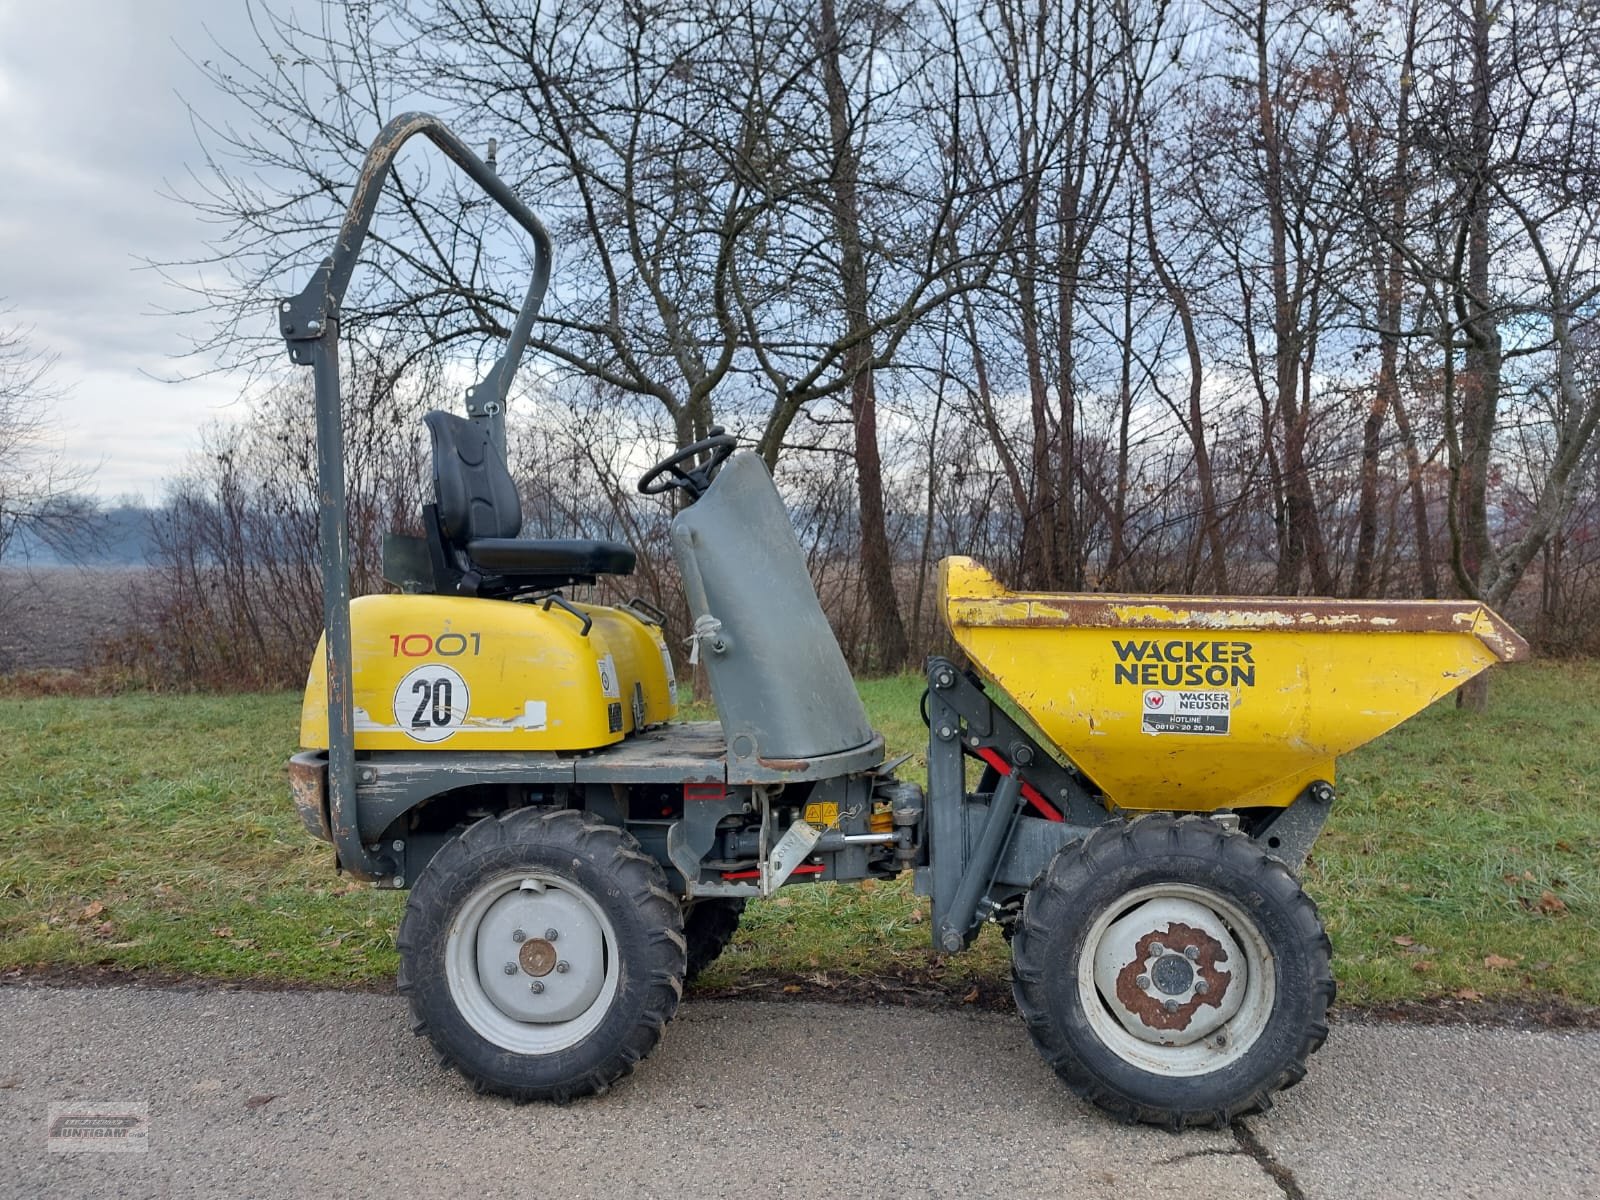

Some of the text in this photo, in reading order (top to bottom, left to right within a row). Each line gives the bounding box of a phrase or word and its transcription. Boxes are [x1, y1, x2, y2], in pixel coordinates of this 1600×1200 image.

[389, 632, 481, 657] 1001
[1112, 640, 1256, 664] WACKER
[1114, 663, 1255, 687] NEUSON
[411, 677, 452, 728] 20
[1179, 692, 1229, 702] WACKER
[1179, 701, 1229, 710] NEUSON
[1170, 716, 1201, 724] HOTLINE
